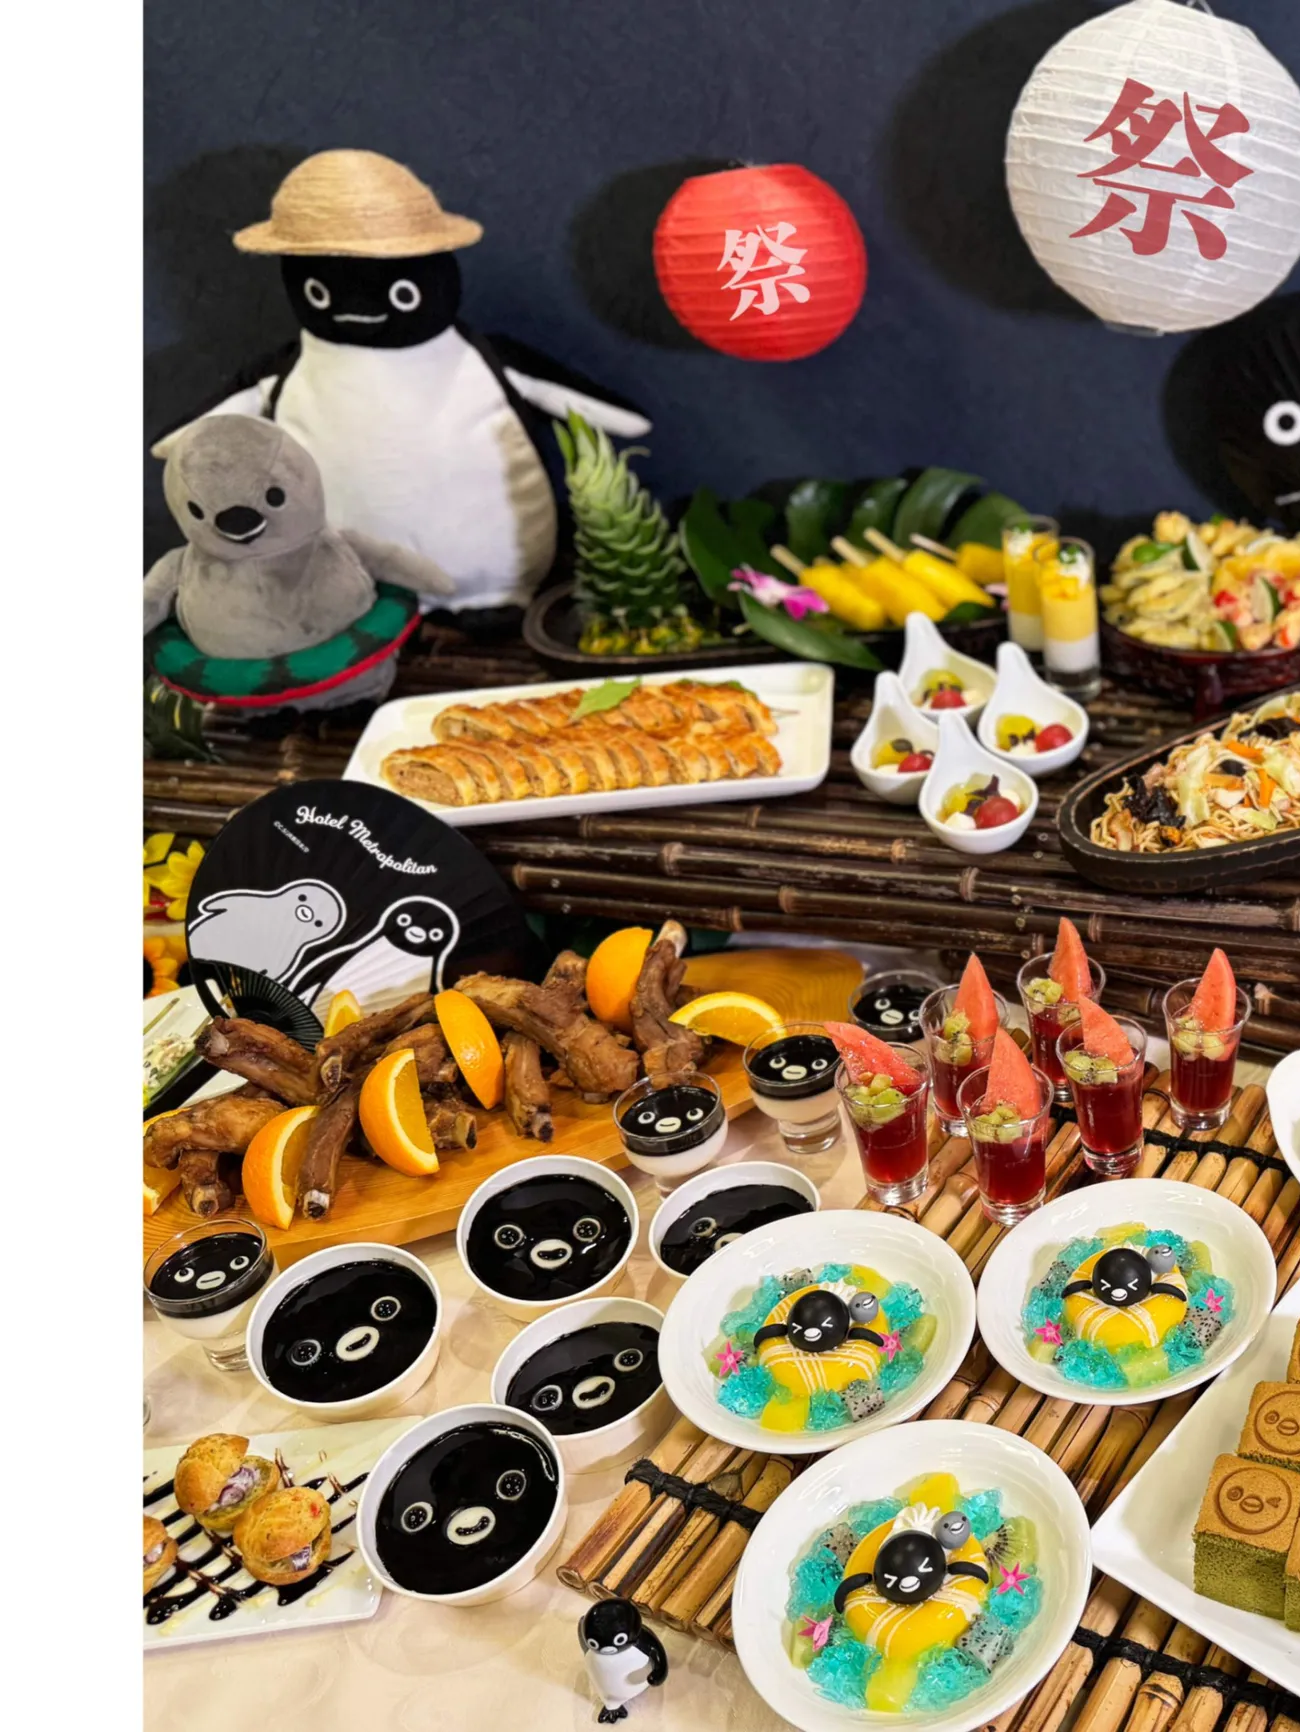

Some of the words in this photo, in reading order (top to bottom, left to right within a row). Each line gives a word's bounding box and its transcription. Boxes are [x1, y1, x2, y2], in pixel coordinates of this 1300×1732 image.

[1069, 78, 1254, 261] 祭
[717, 222, 811, 321] 祭
[295, 806, 349, 830] Hotel
[348, 819, 438, 875] Metropolitan
